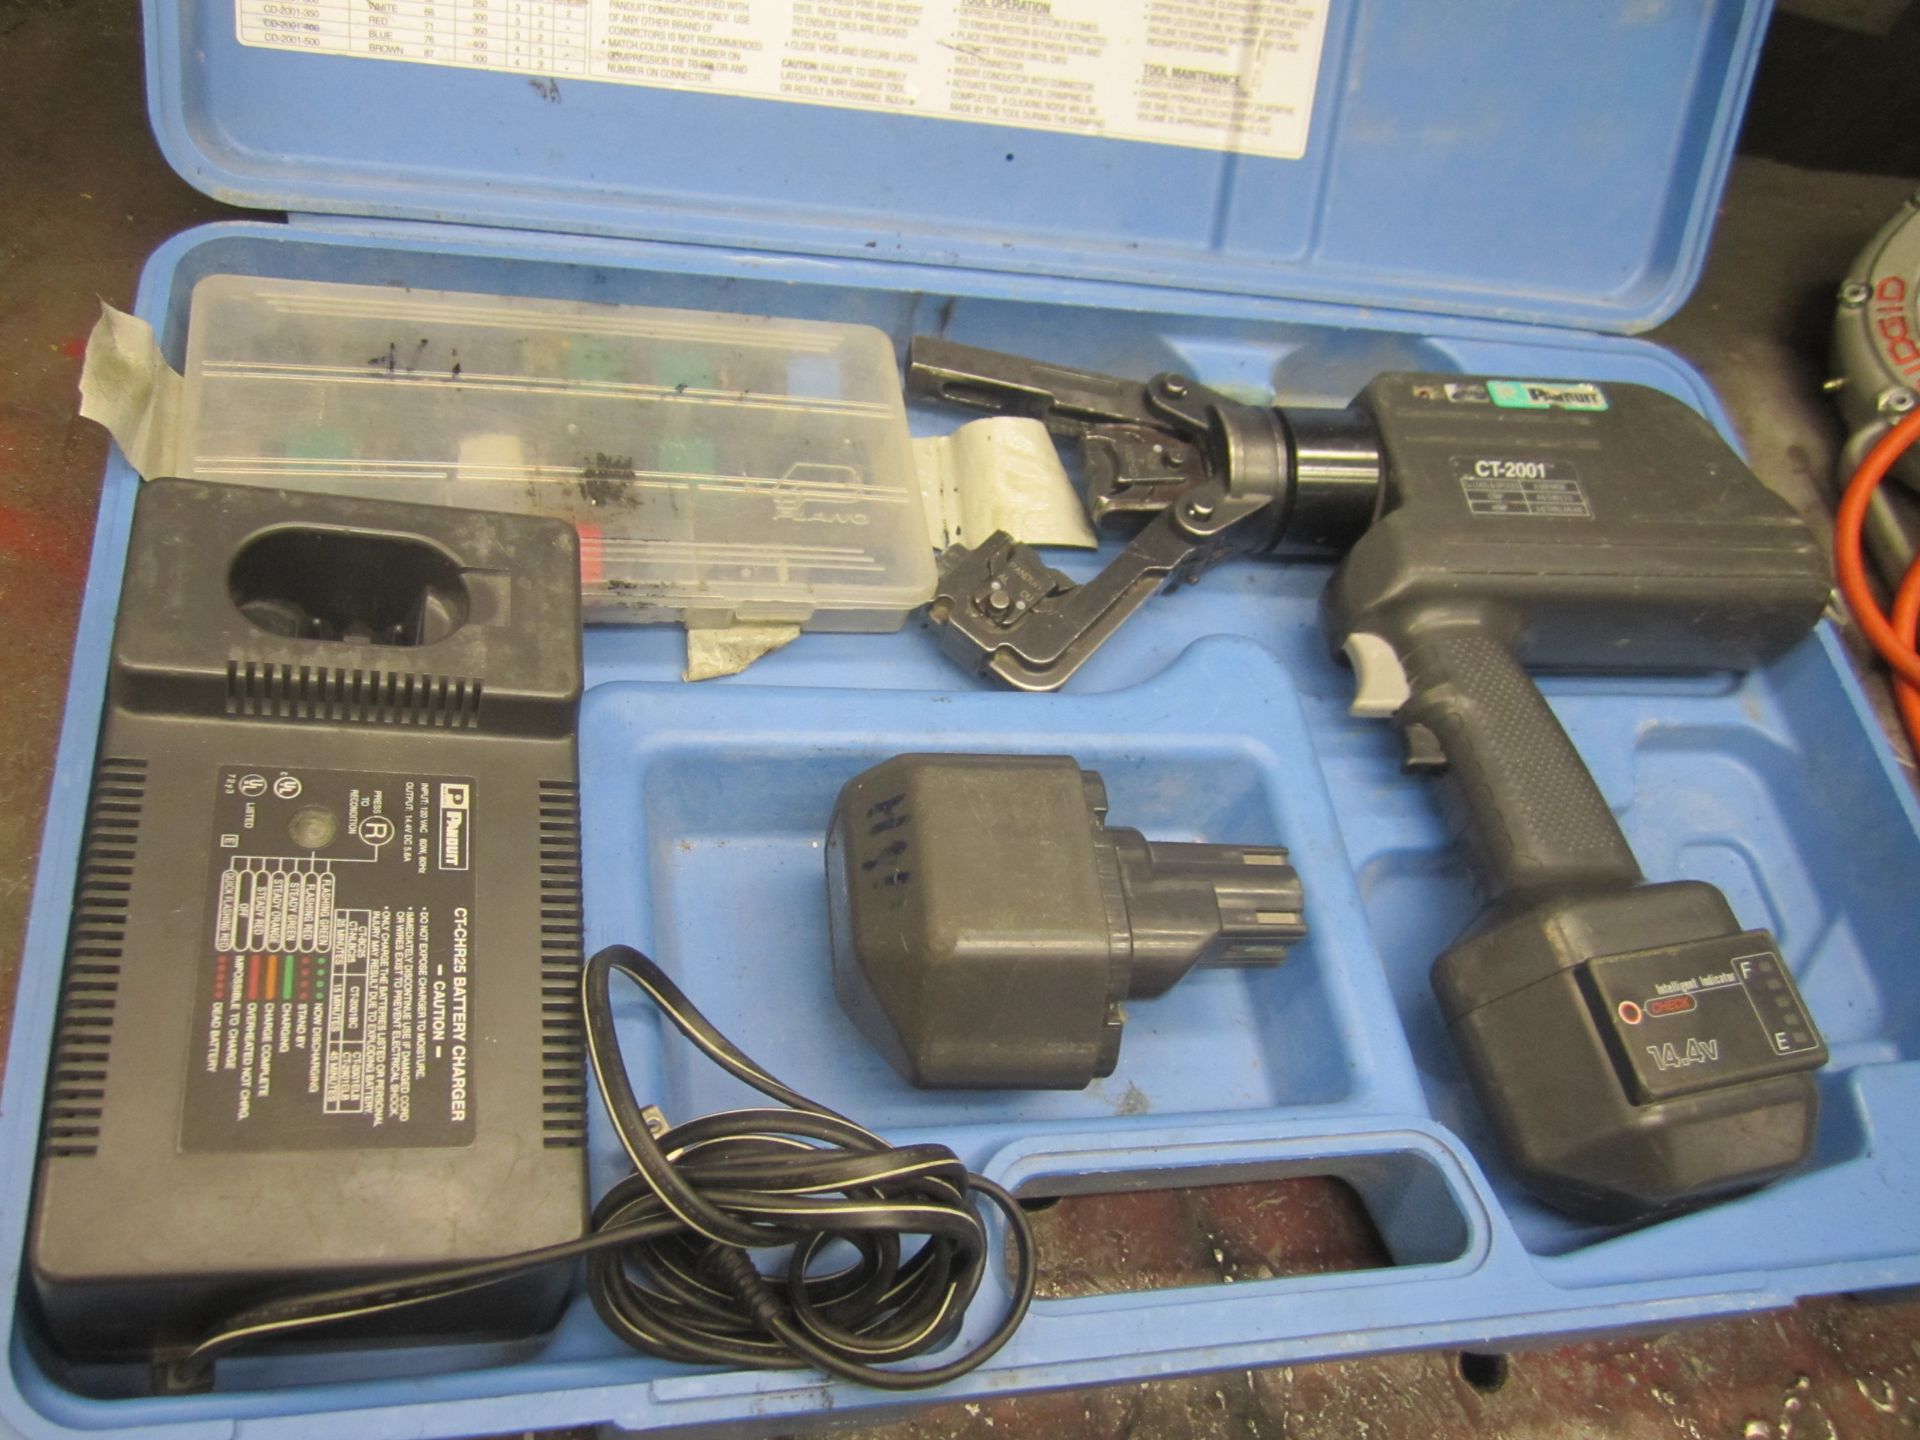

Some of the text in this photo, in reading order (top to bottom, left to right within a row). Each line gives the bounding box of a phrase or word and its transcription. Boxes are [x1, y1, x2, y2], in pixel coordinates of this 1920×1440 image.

[264, 4, 488, 38] CD-2001-350 RED 71 350
[369, 1, 398, 13] WHITE
[472, 13, 488, 24] 300
[608, 0, 646, 12] PANDUIT
[648, 5, 706, 19] CONNECTORS
[734, 15, 750, 24] USE
[992, 0, 1051, 14] OPERATION
[608, 13, 712, 33] OF ANY OTHER BRAND OF
[608, 26, 666, 40] CONNECTORS
[668, 32, 676, 42] IS
[678, 34, 695, 44] NOT
[264, 32, 488, 64] CD-2001-500 BROWN 87 500
[368, 30, 394, 40] BLUE
[472, 40, 488, 50] 400
[608, 39, 740, 61] MATCH COLOR AND NUMBER ON
[608, 64, 711, 82] NUMBER ON CONNECTOR
[672, 58, 684, 67] DIE
[688, 60, 698, 69] TO
[730, 64, 748, 74] AND
[1144, 64, 1168, 78] TOOL
[1474, 460, 1546, 479] CT-2001
[1020, 590, 1034, 602] CU
[244, 802, 256, 829] LISTED
[348, 789, 359, 834] RECONDITION
[360, 796, 370, 807] TO
[372, 790, 382, 814] PRESS
[420, 807, 428, 818] 120
[364, 823, 387, 838] R
[404, 815, 412, 833] 14.4V
[420, 820, 428, 833] VAC
[404, 834, 412, 845] DC
[446, 811, 462, 866] PANDUIT
[418, 856, 427, 874] 60Hz
[218, 872, 236, 948] QUICK FLASHING RED
[239, 903, 249, 918] OFF
[254, 886, 267, 936] STEADY RED
[270, 878, 284, 944] STEADY ORANGE
[286, 882, 300, 940] STEADY GREEN
[303, 884, 316, 940] FLASHING RED
[319, 880, 331, 946] FLASHING GREEN
[420, 912, 428, 924] DO
[371, 911, 380, 939] INJURY
[404, 912, 414, 963] IMMEDIATELY
[419, 925, 428, 942] NOT
[334, 930, 345, 965] MINUTES
[357, 926, 367, 958] CT-BC25
[371, 940, 380, 957] MAY
[418, 943, 428, 976] EXPOSE
[1740, 961, 1752, 980] F
[370, 958, 379, 990] RESULT
[368, 991, 378, 1009] DUE
[390, 912, 404, 1082] OR WIRES EXIST TO PREVENT ELECTRICAL
[402, 964, 413, 1020] DISCONTINUE
[417, 978, 427, 1018] CHARGER
[224, 955, 244, 1070] IMPOSSIBLE TO CHARGE
[330, 984, 342, 1032] 15 MINUTES
[348, 986, 360, 1029] CT-2001BC
[368, 1010, 377, 1022] TO
[372, 911, 390, 1128] ONLY CHARGE THE BATTERIES LISTED OR PERSONAL
[432, 981, 446, 1040] CAUTION
[451, 907, 467, 1122] CT-CHR25 BATTERY CHARGER
[206, 1002, 224, 1072] DEAD BATTERY
[242, 1002, 258, 1066] OVERHEATED
[278, 1002, 292, 1053] CHARGING
[296, 1003, 308, 1049] STAND BY
[402, 1022, 412, 1039] USE
[417, 1020, 426, 1032] TO
[257, 1002, 275, 1097] CHARGE COMPLETE
[308, 1002, 324, 1093] NOW DISCHARGING
[366, 1024, 377, 1072] EXPLODING
[1774, 1031, 1790, 1051] E
[240, 1067, 252, 1088] NOT
[327, 1050, 338, 1102] 45 MINUTES
[400, 1051, 410, 1094] DAMAGED
[400, 1095, 410, 1122] CORD
